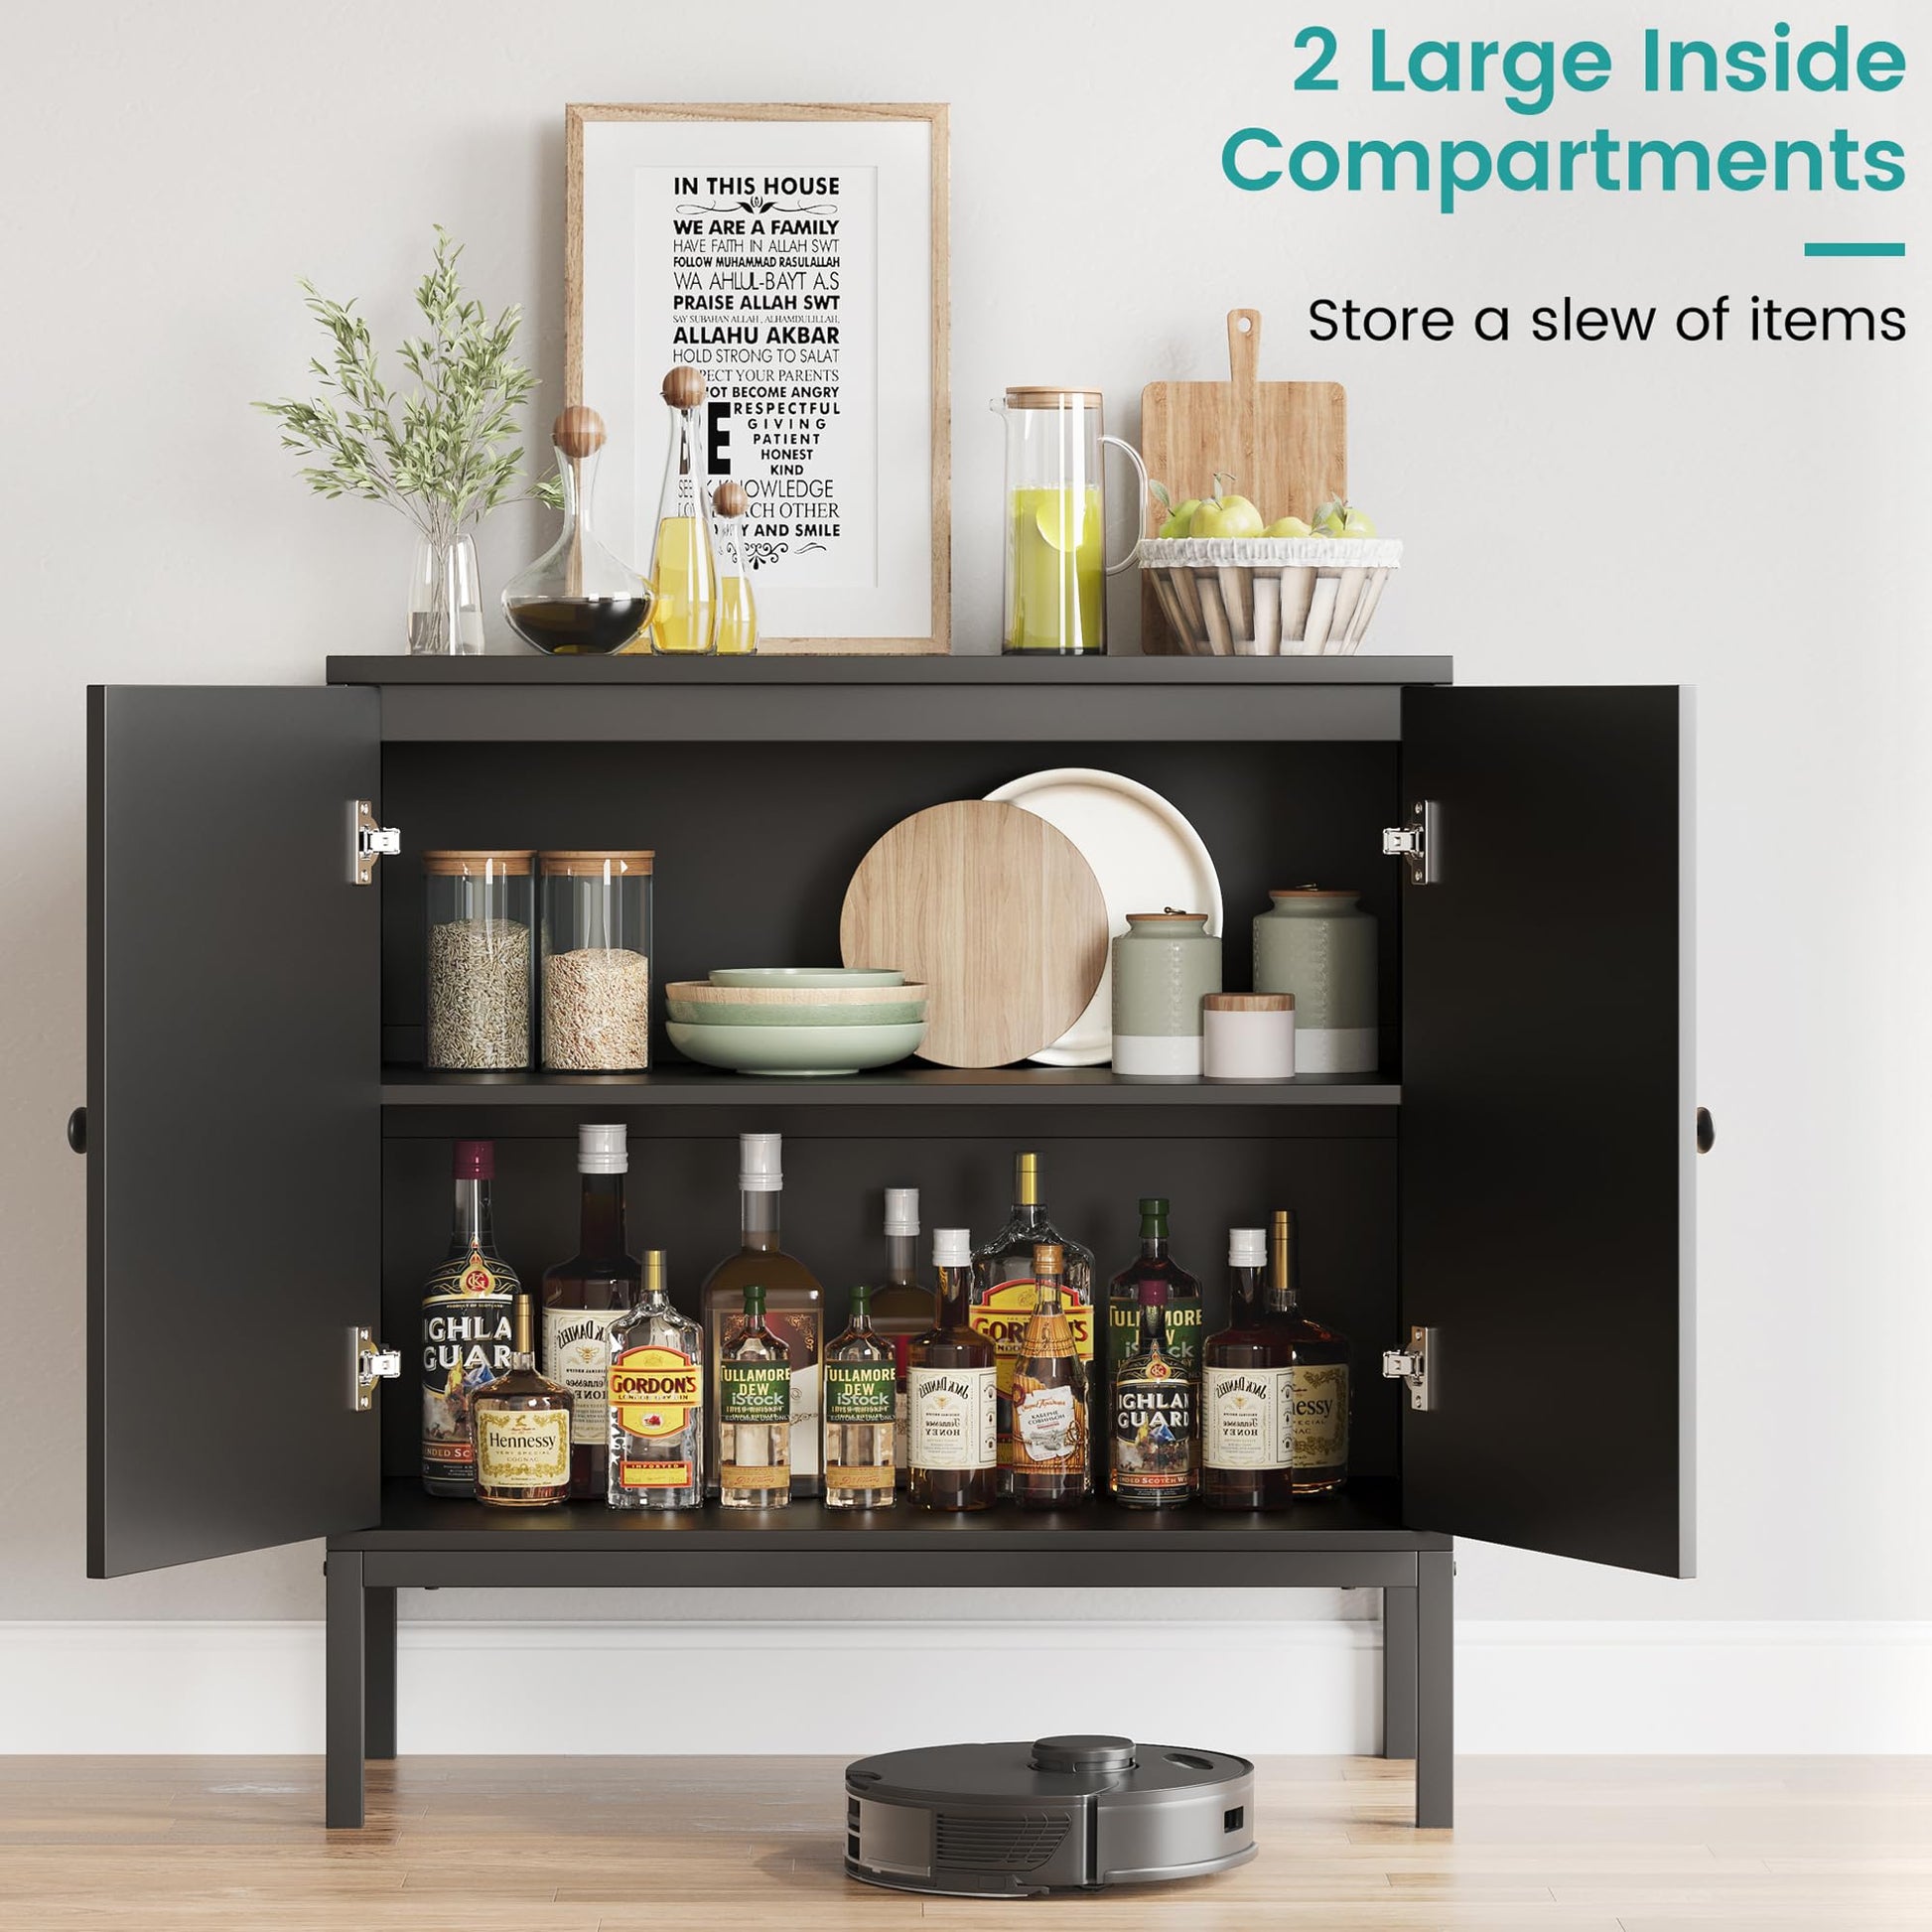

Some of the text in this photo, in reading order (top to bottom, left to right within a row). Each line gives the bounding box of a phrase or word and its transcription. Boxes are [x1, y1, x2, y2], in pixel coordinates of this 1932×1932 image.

[675, 177, 839, 196] IN THIS HOUSE
[673, 220, 839, 234] WE ARE A FAMILY
[673, 239, 840, 253] HAVE FAITH IN ALLAH SWT
[674, 256, 840, 268] FOLLOW MUHAMMAD RASULALLAH
[674, 271, 840, 291] WA AHLUL-BAYT A.S
[674, 295, 840, 310] PRAISE ALLAH SWT
[673, 327, 840, 345] ALLAHU AKBAR
[673, 348, 840, 363] HOLD STRONG TO SALAT
[736, 369, 774, 382] YOUR
[779, 369, 839, 382] PARENTS
[733, 386, 786, 399] BECOME
[791, 386, 840, 399] ANGRY
[734, 402, 841, 415] RESPECTFUL
[748, 418, 826, 430] GIVING
[754, 434, 820, 445] PATIENT
[761, 449, 813, 460] HONEST
[770, 465, 803, 476] KIND
[779, 502, 840, 519] OTHER
[755, 524, 789, 537] AND
[795, 524, 840, 537] SMILE
[612, 1375, 697, 1394] GORDON'S
[739, 1383, 770, 1396] DEW
[845, 1383, 875, 1396] DEW
[732, 1392, 784, 1406] iStock
[837, 1393, 890, 1406] iStock
[1118, 1411, 1189, 1428] GUARD
[489, 1433, 556, 1450] Hennessy
[1142, 1476, 1176, 1485] SCOTCH
